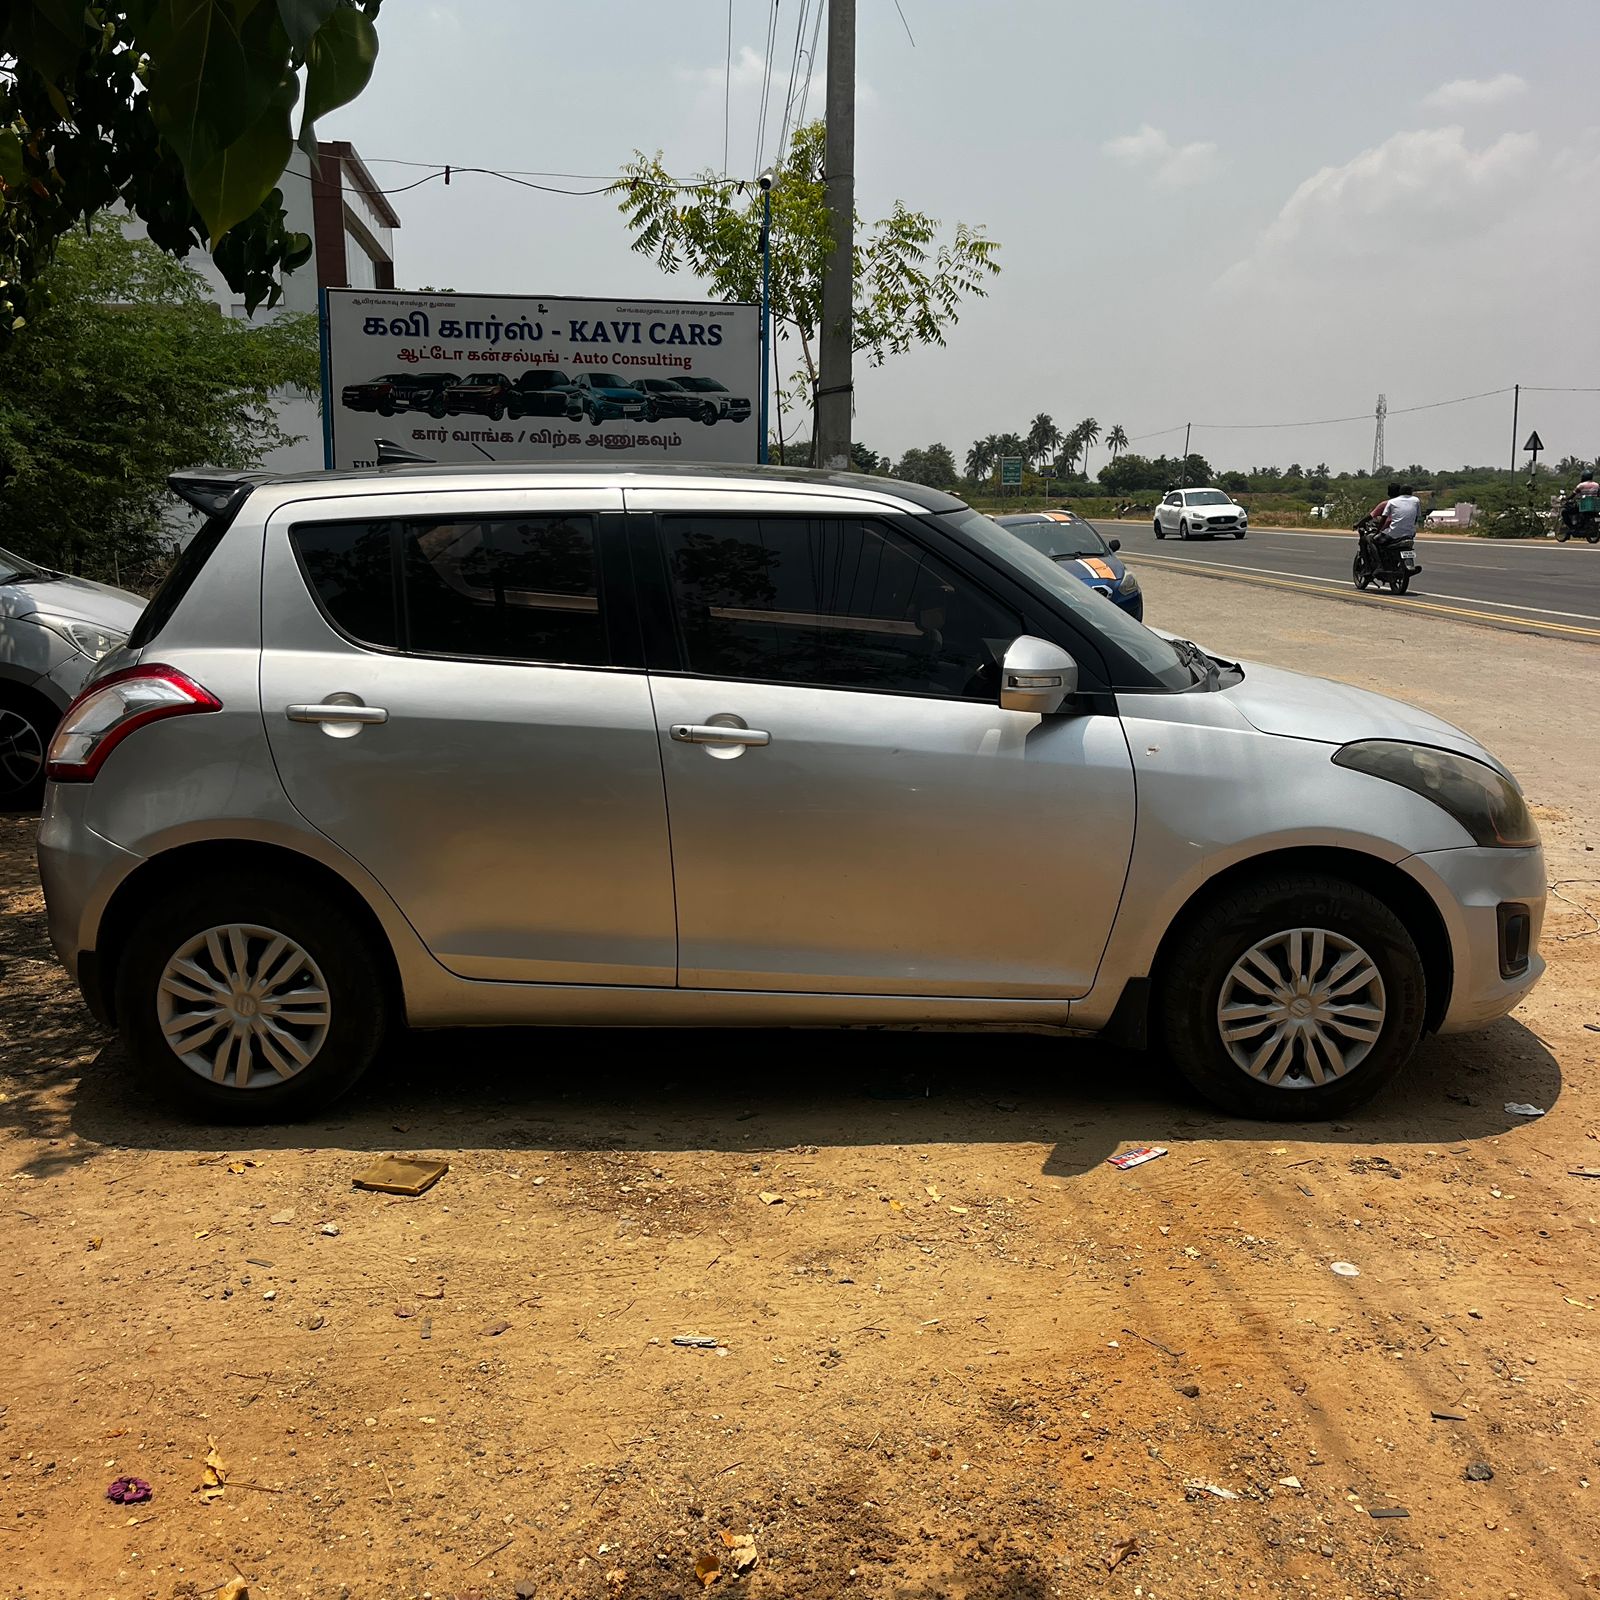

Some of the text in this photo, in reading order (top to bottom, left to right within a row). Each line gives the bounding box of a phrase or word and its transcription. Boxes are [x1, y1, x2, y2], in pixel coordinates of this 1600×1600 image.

[363, 310, 430, 338] கவி
[438, 313, 544, 345] கார்ஸ்
[569, 320, 642, 344] KAVI
[648, 322, 723, 347] CARS
[396, 345, 464, 364] ஆட்டோ
[467, 348, 560, 367] கன்சல்டிங்
[572, 352, 609, 365] Auto
[611, 352, 693, 370] Consulting
[411, 426, 682, 451] கார் வாங்க / விற்க அணுகவும்
